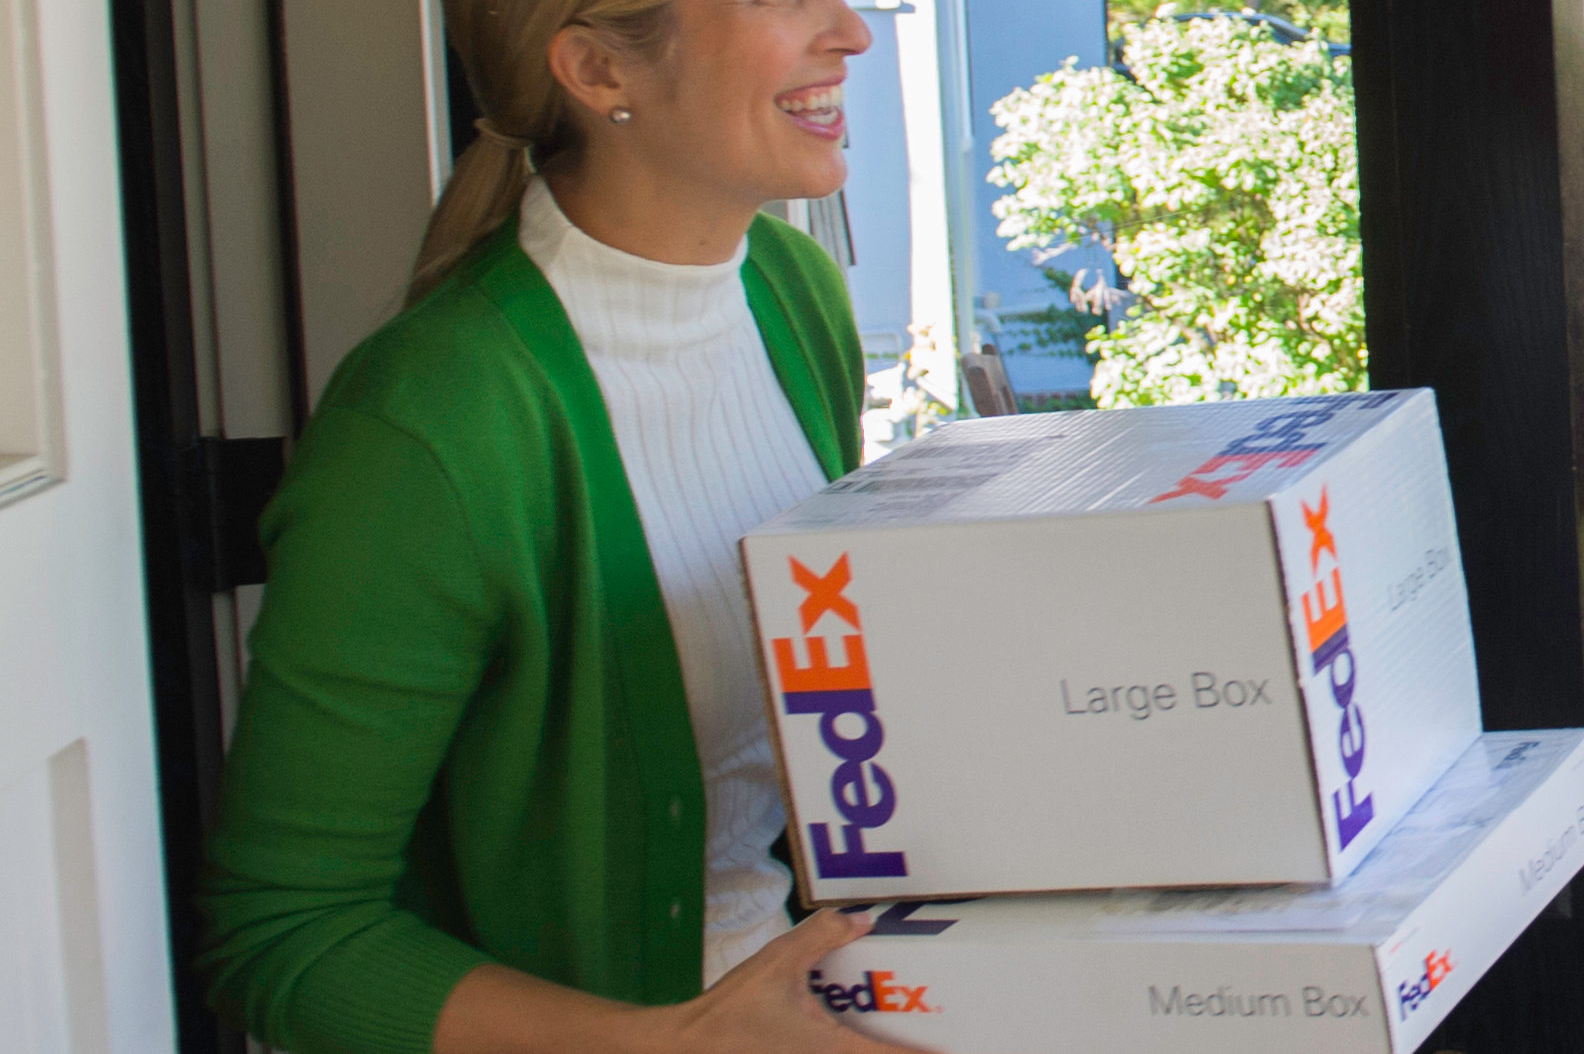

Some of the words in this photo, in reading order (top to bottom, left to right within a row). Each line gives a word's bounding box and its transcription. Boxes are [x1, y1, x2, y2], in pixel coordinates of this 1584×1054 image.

[1059, 678, 1178, 720] Large
[1190, 671, 1273, 709] Box
[1300, 481, 1375, 853] FedEx
[770, 550, 910, 880] FedEx
[1148, 984, 1293, 1017] Medium
[1301, 984, 1371, 1018] Box
[1396, 949, 1454, 1023] FedEx
